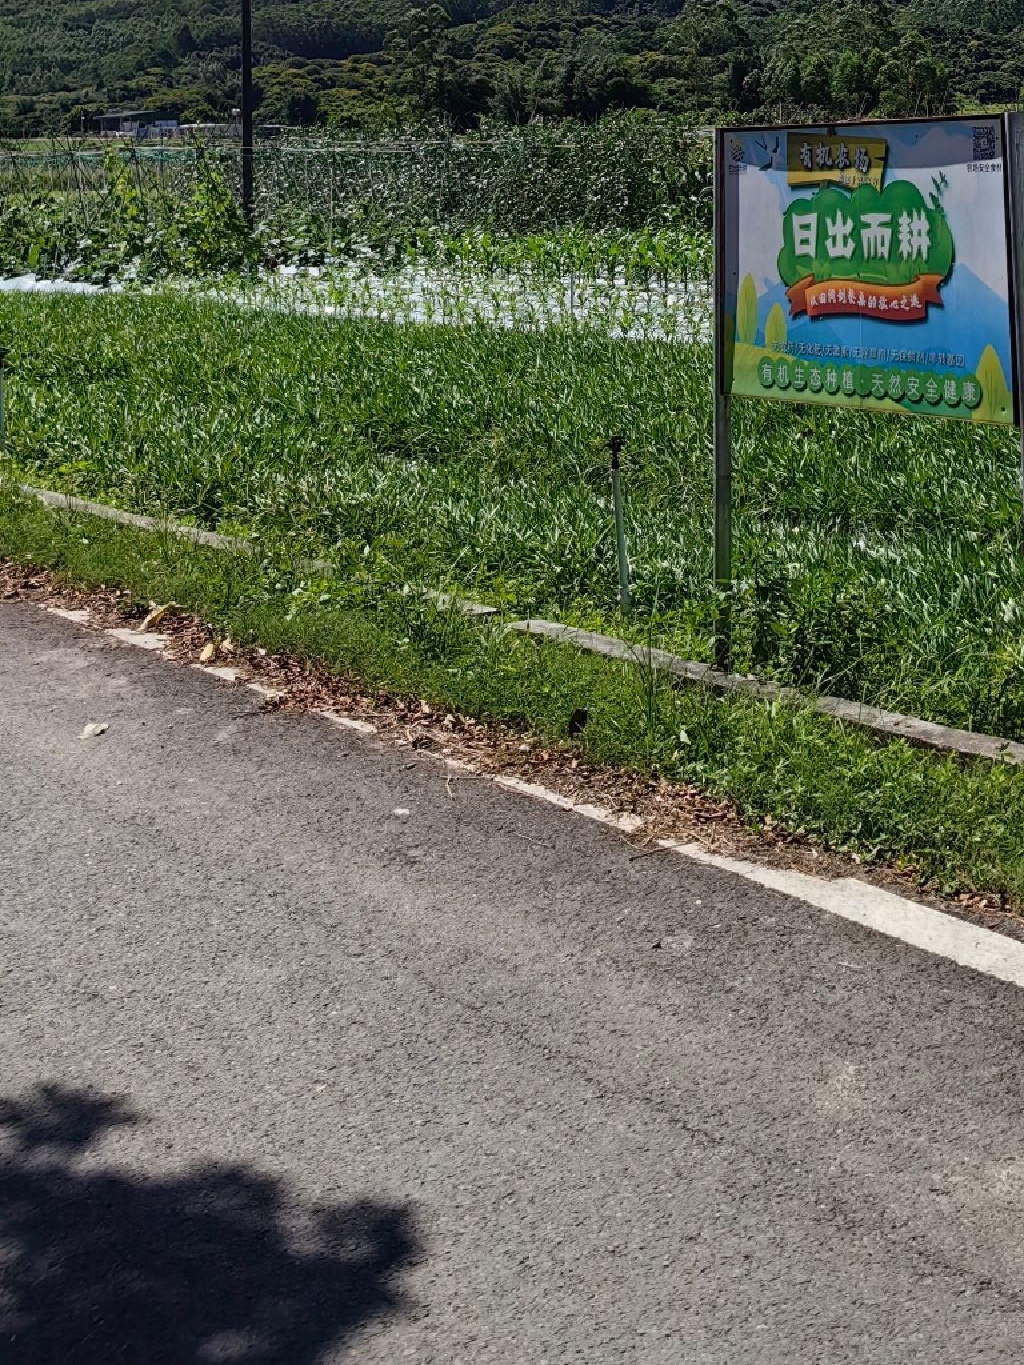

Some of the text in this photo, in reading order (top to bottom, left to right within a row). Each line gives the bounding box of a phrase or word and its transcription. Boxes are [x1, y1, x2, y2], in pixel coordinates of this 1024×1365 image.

[799, 141, 870, 173] 有机农场
[791, 208, 932, 261] 日出而耕
